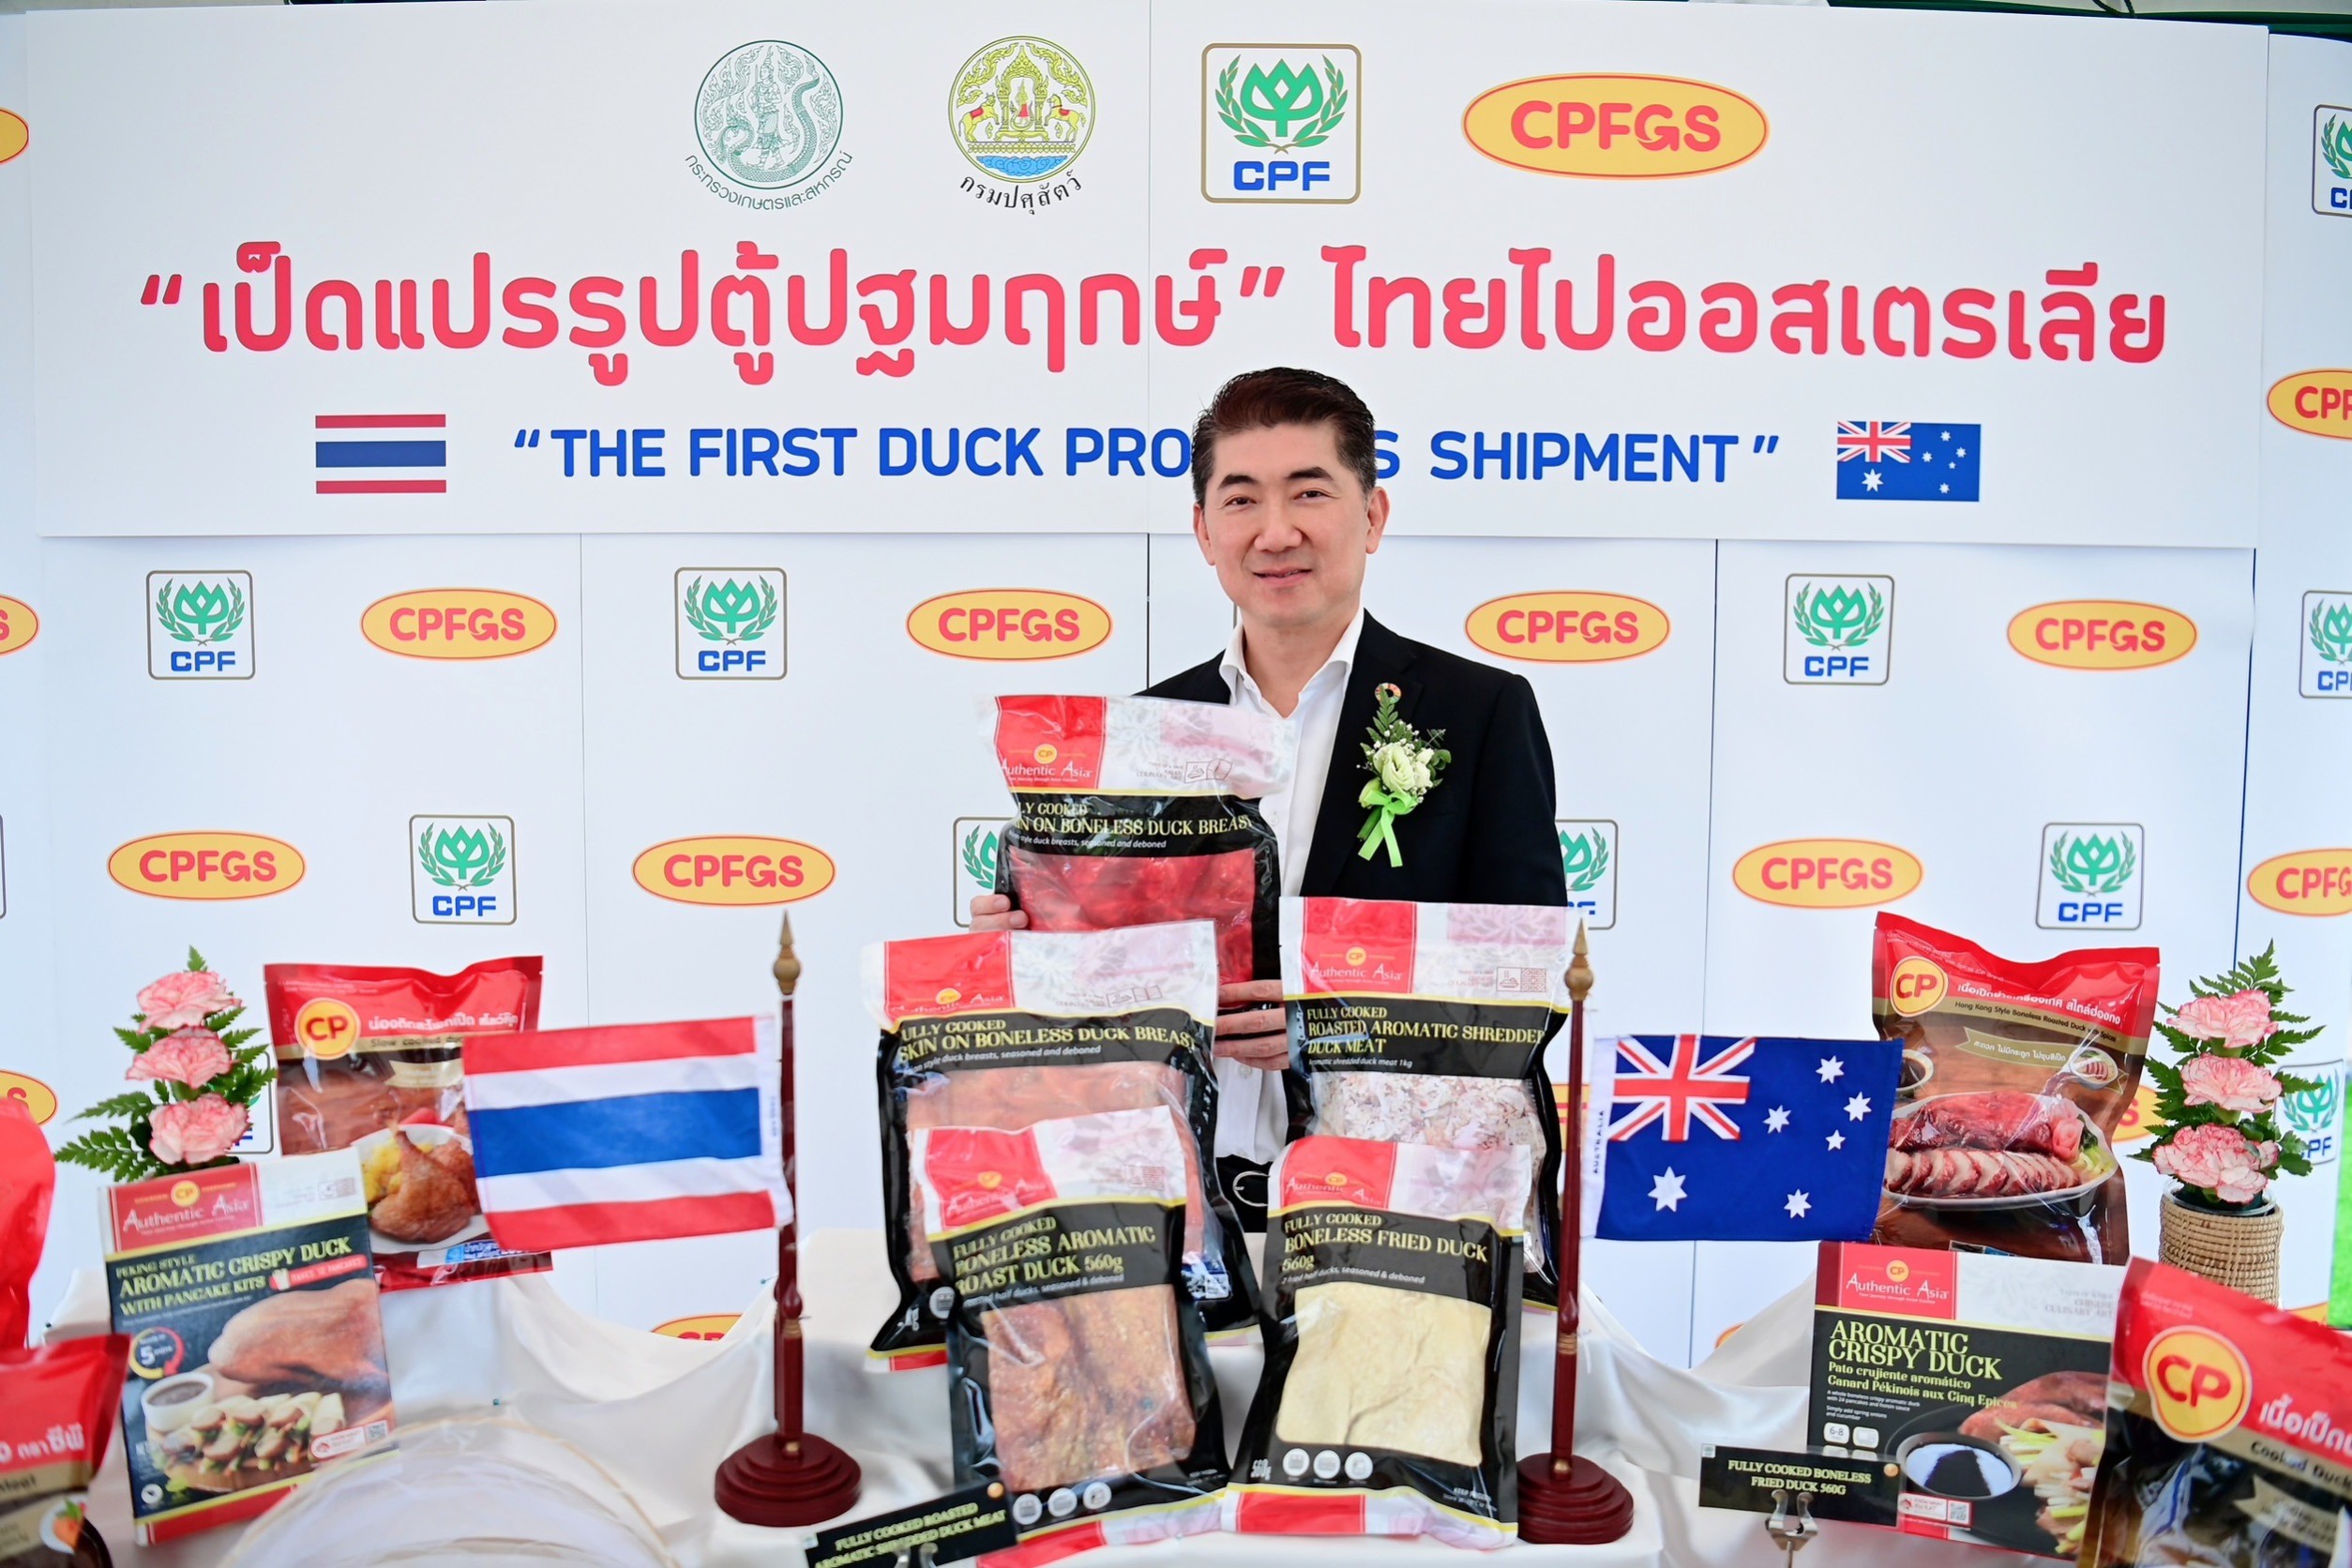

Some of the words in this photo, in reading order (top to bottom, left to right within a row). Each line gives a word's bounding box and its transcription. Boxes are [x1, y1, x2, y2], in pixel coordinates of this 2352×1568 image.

[1511, 100, 1722, 152] CPFGS
[686, 150, 852, 210] กระทรวงเกษตรและสหกรณ์
[1233, 160, 1331, 191] CPF
[959, 171, 1082, 216] กรมปศุสัตว์
[1321, 245, 2166, 364] ไทยไปออสเตรเลีย
[690, 428, 857, 477] FIRST
[879, 428, 1043, 476] DUCK
[389, 607, 526, 641] CPFGS
[938, 608, 1080, 642] CPFGS
[1497, 611, 1639, 644] CPFGS
[2035, 618, 2166, 652] CPFGS
[171, 651, 236, 672] CPF
[698, 650, 766, 671] CPF
[1804, 656, 1869, 677] CPF
[2318, 671, 2352, 691] CP
[1061, 761, 1092, 777] Asia
[1033, 818, 1057, 833] ON
[1061, 818, 1143, 835] BONELESS
[1148, 820, 1194, 836] DUCK
[139, 850, 277, 882] CPFGS
[663, 853, 804, 888] CPFGS
[1760, 857, 1893, 891] CPFGS
[432, 896, 497, 917] CPF
[2058, 901, 2122, 923] CPF
[1373, 963, 1403, 981] Asia
[1895, 972, 1937, 999] CP
[1306, 1007, 1338, 1020] FULLY
[1340, 1005, 1387, 1019] COOKED
[1954, 1001, 1973, 1013] Hong
[1974, 1003, 1994, 1016] Kong
[1994, 1005, 2011, 1017] Style
[2012, 1008, 2042, 1022] Boneless
[2043, 1014, 2069, 1028] Roasted
[2070, 1018, 2087, 1033] Duck
[305, 1015, 349, 1041] CP
[901, 1024, 940, 1043] ULLY
[945, 1018, 1006, 1033] COOKED
[1307, 1019, 1366, 1037] ROASTED
[1370, 1020, 1458, 1040] AROMATIC
[898, 1034, 939, 1063] SKIN
[942, 1033, 970, 1050] ON
[974, 1028, 1074, 1048] BONELESS
[1078, 1027, 1130, 1043] DUCK
[942, 1051, 964, 1064] duck
[1043, 1046, 1062, 1057] and
[1063, 1044, 1102, 1056] deboned
[1307, 1041, 1342, 1055] DUCK
[1345, 1038, 1387, 1054] MEAT
[1593, 1110, 1605, 1174] AUSTRALIA
[2300, 1137, 2331, 1158] PF
[123, 1207, 204, 1232] Authentic
[1284, 1213, 1323, 1234] FULLY
[1325, 1212, 1381, 1227] COOKED
[954, 1235, 998, 1260] FULLY
[1000, 1216, 1057, 1243] COOKED
[955, 1235, 1052, 1277] BONELESS
[1057, 1226, 1156, 1252] AROMATIC
[1284, 1227, 1373, 1254] BONELESS
[1377, 1229, 1432, 1252] FRIED
[1435, 1236, 1488, 1263] DUCK
[119, 1259, 225, 1298] AROMATIC
[228, 1244, 296, 1276] CRISPY
[300, 1236, 354, 1262] DUCK
[1023, 1254, 1080, 1282] DUCK
[1084, 1253, 1124, 1273] 560g
[1281, 1254, 1315, 1273] 560g
[1341, 1266, 1380, 1279] seasoned
[1388, 1271, 1425, 1285] deboned
[1890, 1266, 1905, 1275] CP
[119, 1295, 163, 1317] WITH
[164, 1282, 233, 1308] PANCAKE
[233, 1274, 267, 1294] KITS
[1846, 1272, 1911, 1296] Authentic
[1916, 1279, 1950, 1300] Asia
[1830, 1319, 1969, 1355] AROMATIC
[140, 1345, 155, 1365] 5
[1828, 1337, 1922, 1370] CRISPY
[1928, 1350, 2003, 1380] DUCK
[1828, 1360, 1854, 1375] Pato
[1855, 1364, 1908, 1382] crujiente
[1909, 1372, 1971, 1391] aromático
[2157, 1354, 2231, 1408] CP
[1827, 1374, 1869, 1392] Canard
[1871, 1380, 1921, 1398] Pékinois
[1922, 1388, 1945, 1401] aux
[1947, 1389, 1976, 1408] Cinq
[1829, 1426, 1844, 1437] 6-8
[1727, 1459, 1764, 1472] FULLY
[1764, 1464, 1814, 1478] COOKED
[1813, 1469, 1872, 1485] BONELESS
[1751, 1476, 1786, 1489] FRIED
[1786, 1480, 1819, 1493] DUCK
[1819, 1484, 1847, 1496] 560G
[835, 1530, 873, 1552] FULLY
[873, 1517, 924, 1540] COOKED
[924, 1501, 979, 1527] ROASTED
[939, 1519, 974, 1538] DUCK
[973, 1508, 1007, 1529] MEAT
